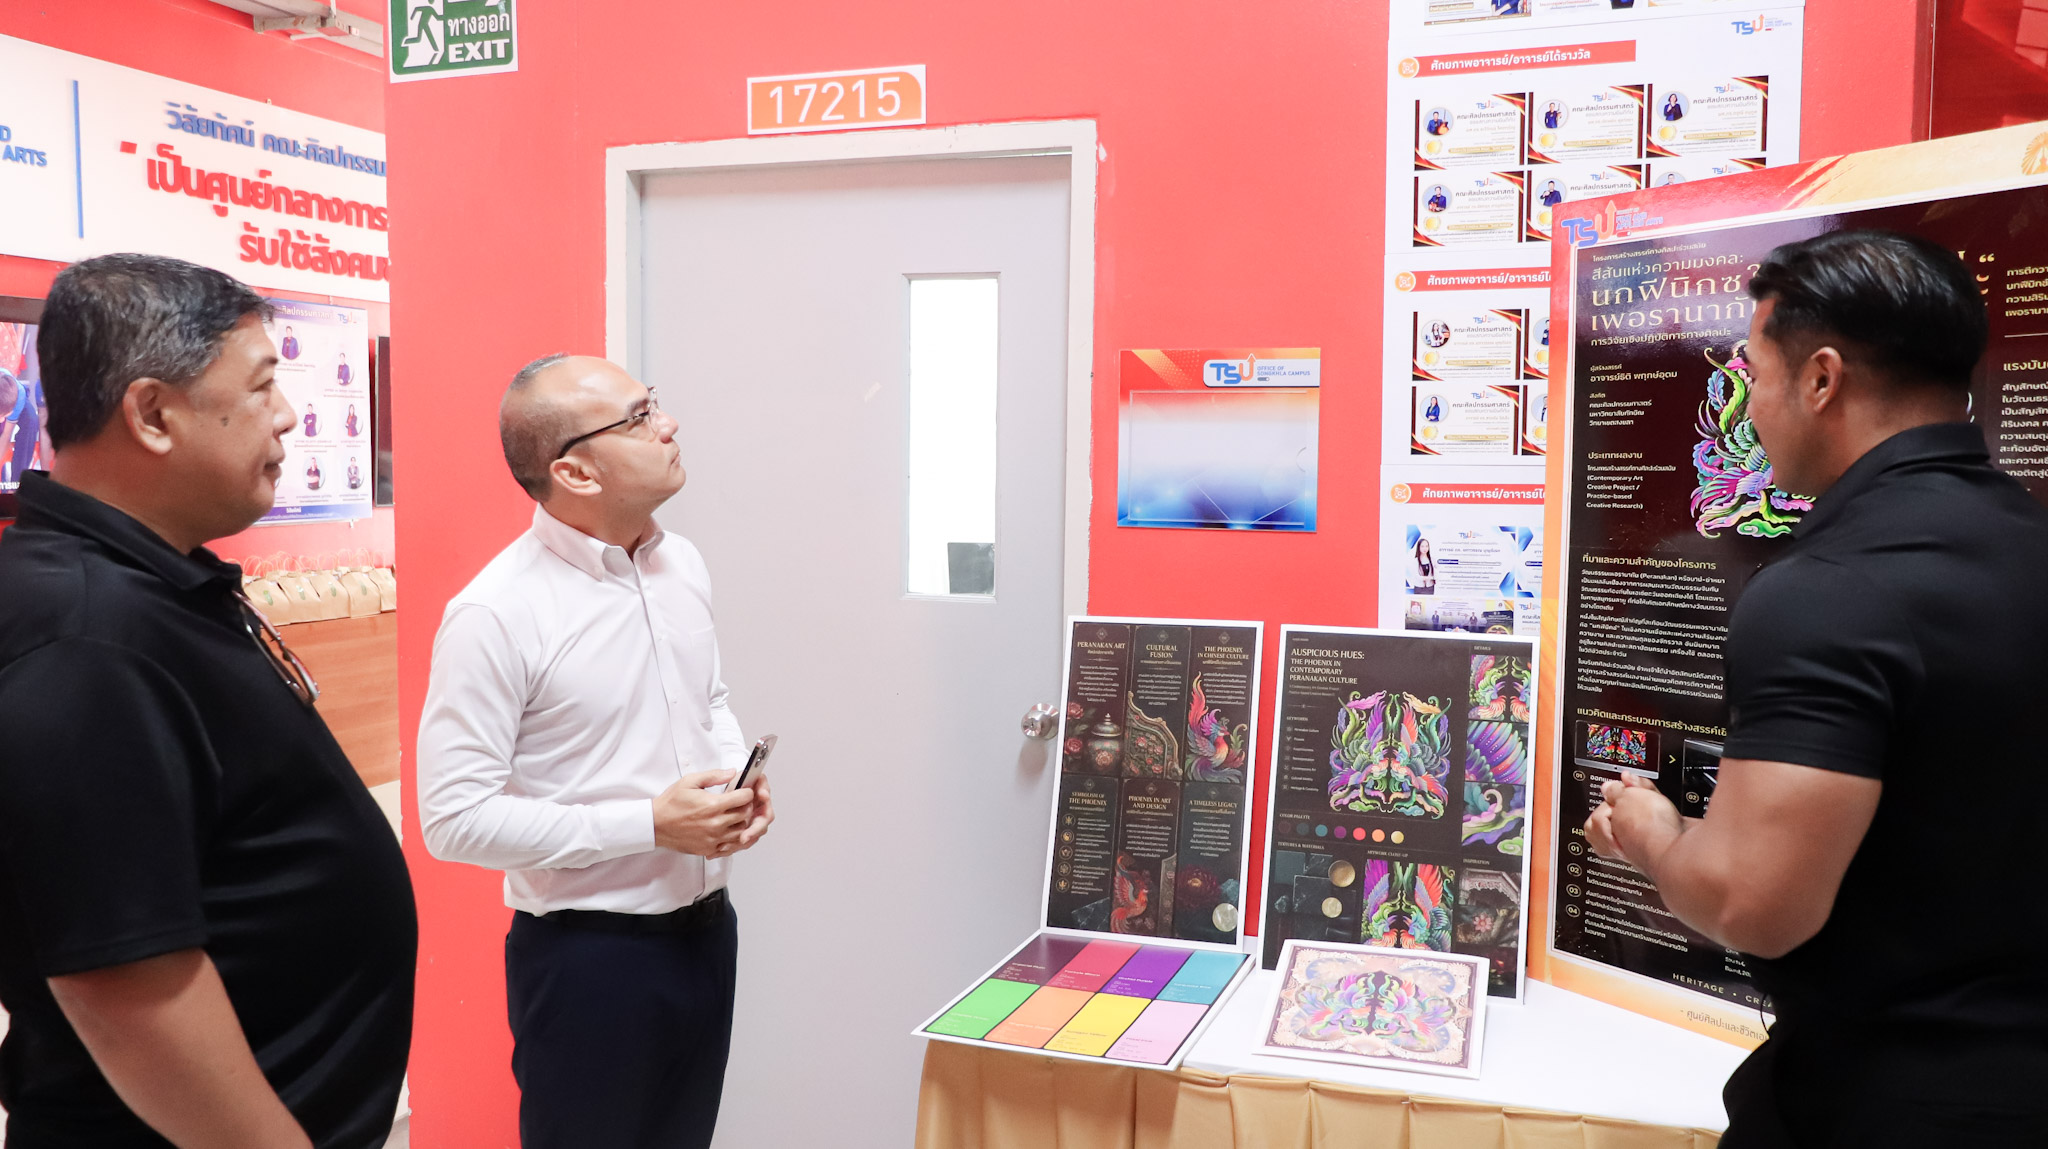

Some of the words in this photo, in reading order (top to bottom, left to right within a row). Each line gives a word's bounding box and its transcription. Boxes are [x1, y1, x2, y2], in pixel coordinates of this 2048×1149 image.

[448, 12, 510, 36] ทางออก
[1731, 14, 1764, 35] TSU
[448, 38, 510, 63] EXIT
[769, 76, 901, 124] 17215
[165, 101, 255, 147] วิสัยทัศน์
[2, 144, 48, 167] ARTS
[1561, 199, 1617, 247] TSU
[1591, 296, 1757, 331] เพอรานากั
[1209, 353, 1256, 384] TSU
[1612, 502, 1644, 510] Research)
[1582, 552, 1716, 570] ที่มาและความสำคัญของโครงการ
[1146, 644, 1178, 652] CULTURAL
[1291, 648, 1338, 658] AUSPICIOUS
[1340, 650, 1364, 659] HUES:
[1290, 666, 1342, 675] CONTEMPORARY
[1290, 674, 1327, 682] PERANAKAN
[1577, 707, 1728, 737] แนวคิดและกระบวนการสร้างสรรค์เชิ
[1082, 798, 1108, 806] PHOENIX
[1570, 866, 1579, 874] 02
[1568, 906, 1578, 914] 04
[1672, 973, 1724, 994] HERITAGE
[1686, 1009, 1768, 1042] ศูนย์ศิลปะและชีวิตเอ
